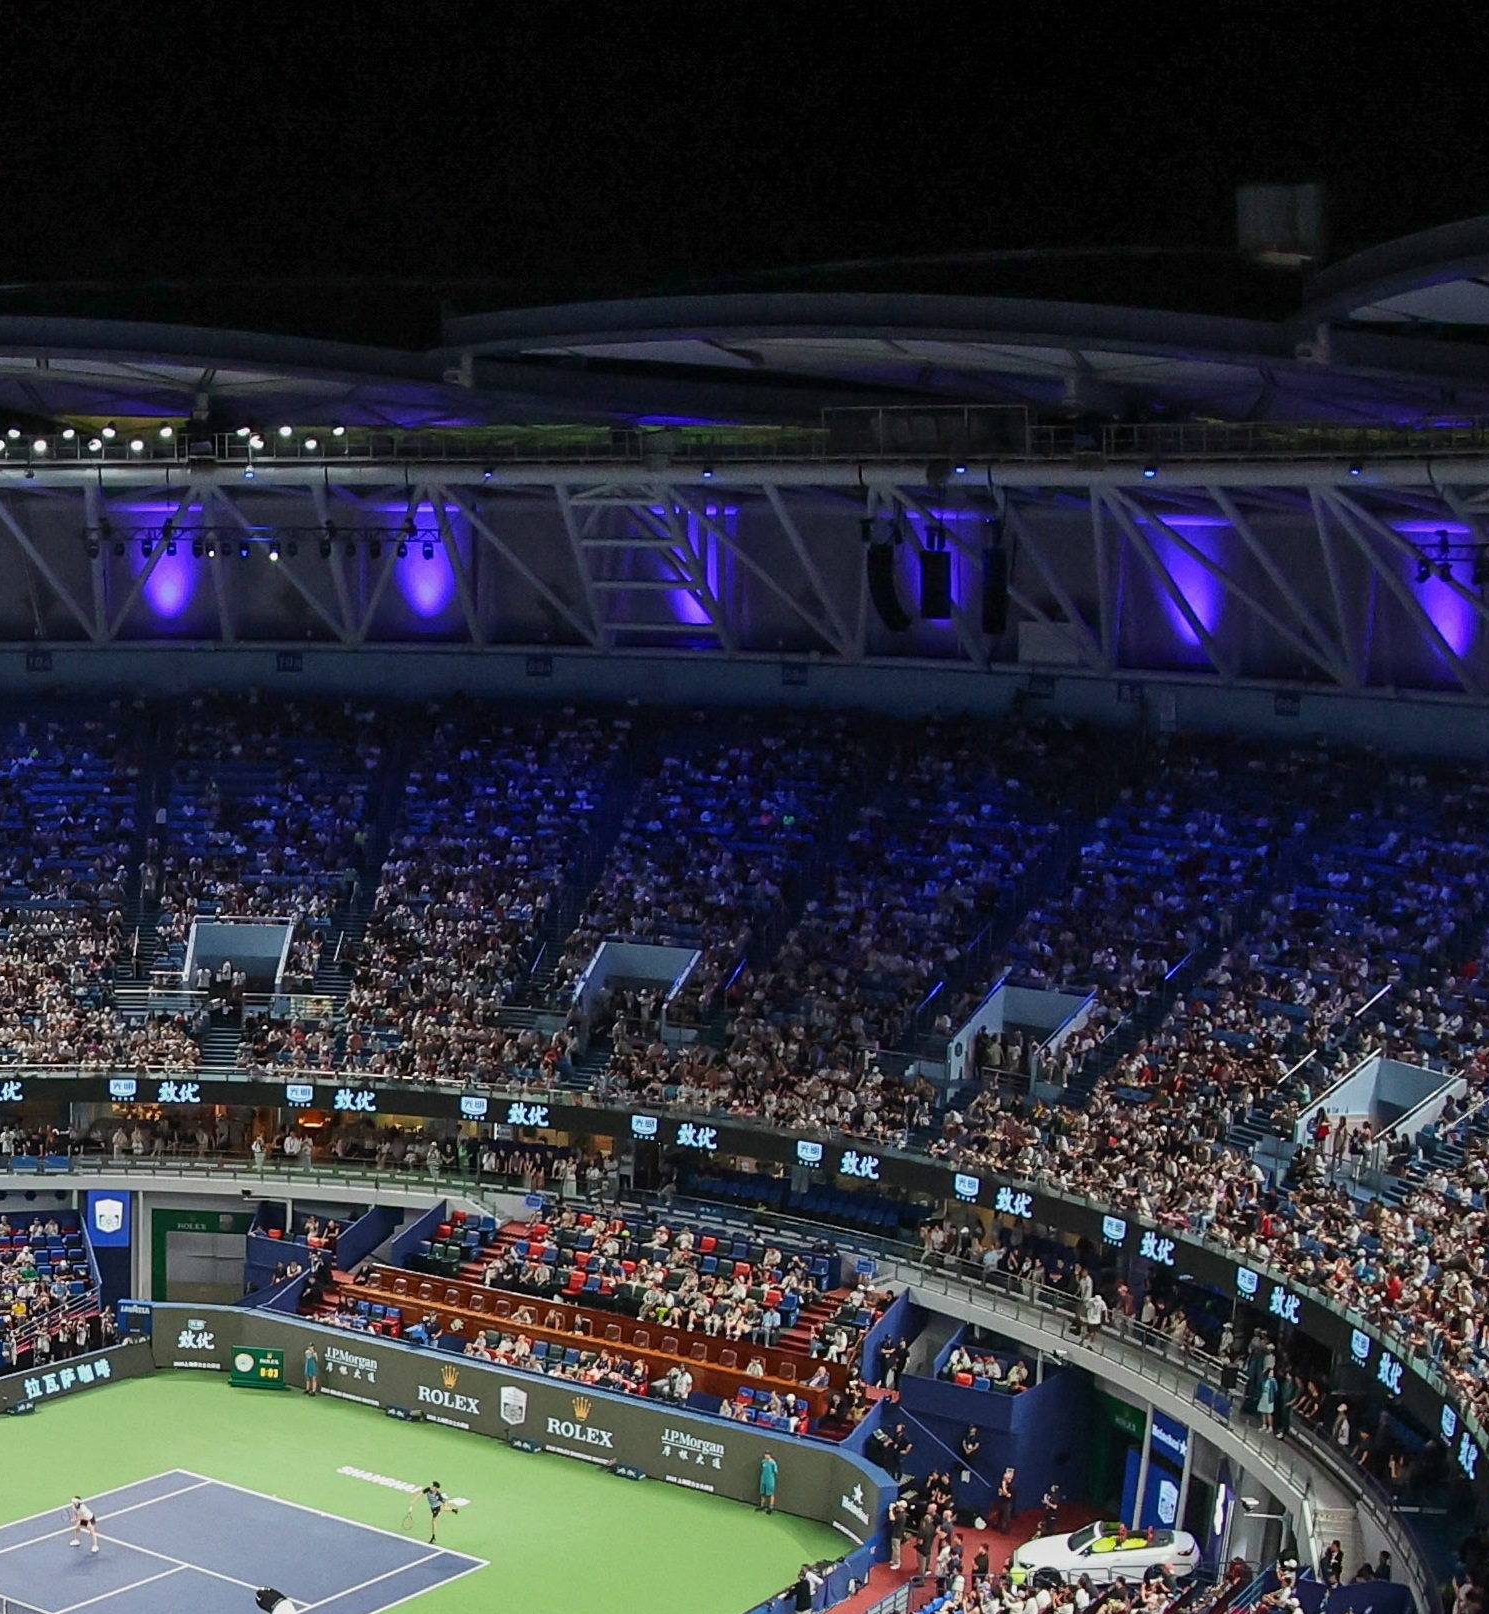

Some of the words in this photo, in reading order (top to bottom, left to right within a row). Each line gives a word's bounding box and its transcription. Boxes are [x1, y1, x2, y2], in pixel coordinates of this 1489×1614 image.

[157, 1081, 200, 1105] 致优
[334, 1089, 376, 1111] 致优
[508, 1101, 548, 1126] 致优
[677, 1123, 716, 1149] 致优
[841, 1151, 879, 1179] 致优
[996, 1188, 1032, 1217] 致优
[1140, 1232, 1174, 1265] 致优
[1270, 1285, 1302, 1323] 致优
[177, 1330, 216, 1350] 致优
[324, 1346, 378, 1370] J.P.Morgan
[24, 1358, 112, 1399] 拉瓦萨咖啡
[418, 1385, 481, 1415] ROLEX
[546, 1417, 614, 1449] ROLEX
[661, 1428, 725, 1456] J.P.Morgan
